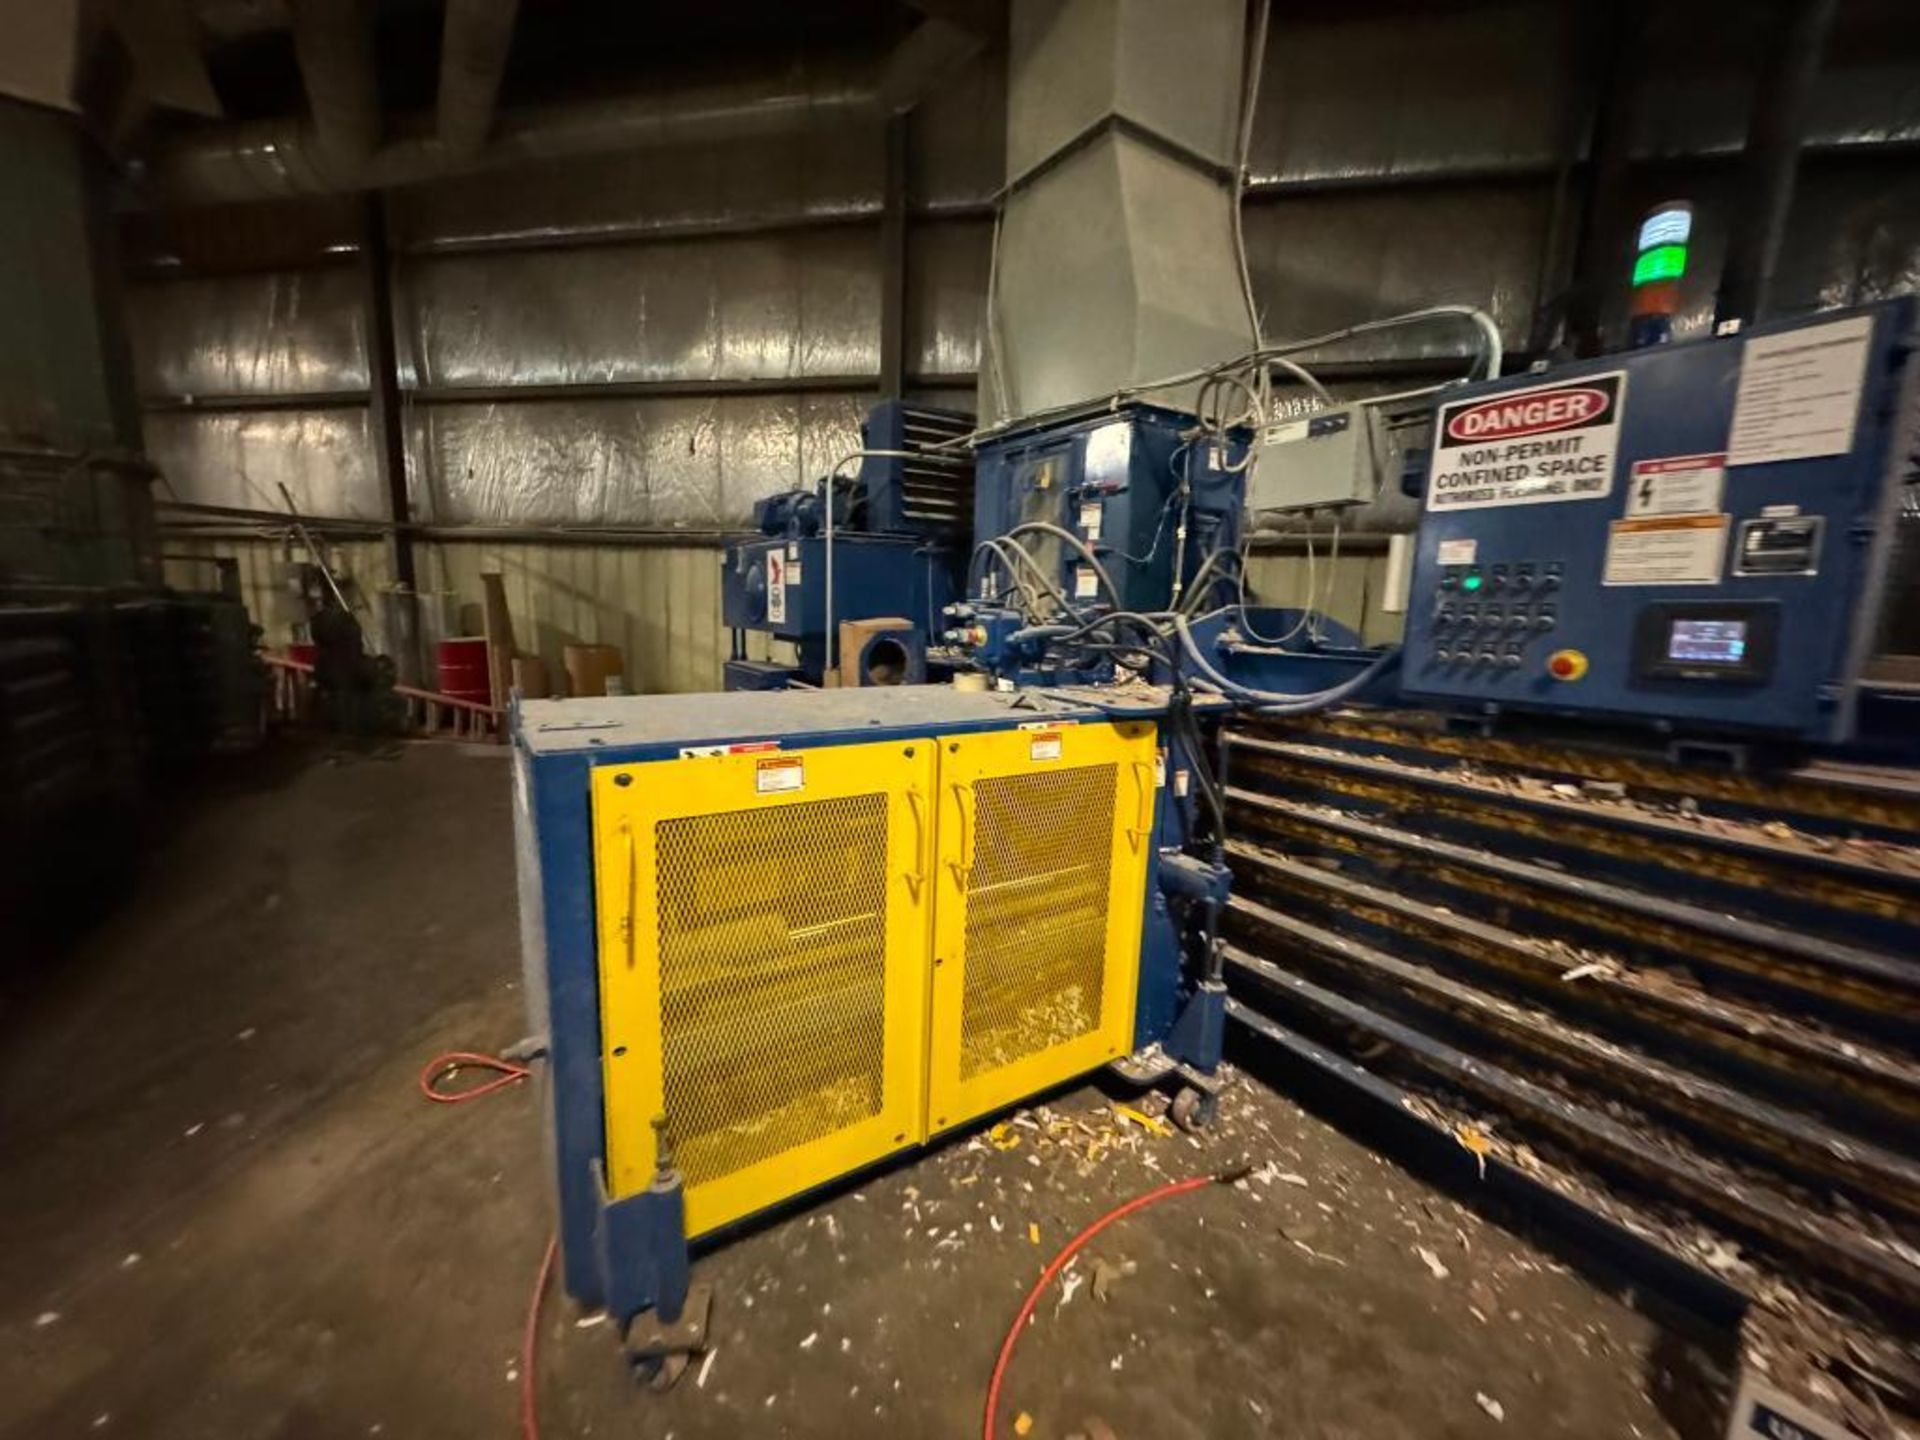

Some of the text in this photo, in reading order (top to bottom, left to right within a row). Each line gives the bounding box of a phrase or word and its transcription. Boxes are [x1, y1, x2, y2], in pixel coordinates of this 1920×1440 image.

[1464, 395, 1590, 435] DANGER
[1460, 437, 1584, 467] NON-PERMIT
[1437, 455, 1607, 489] CONFINED SPACE
